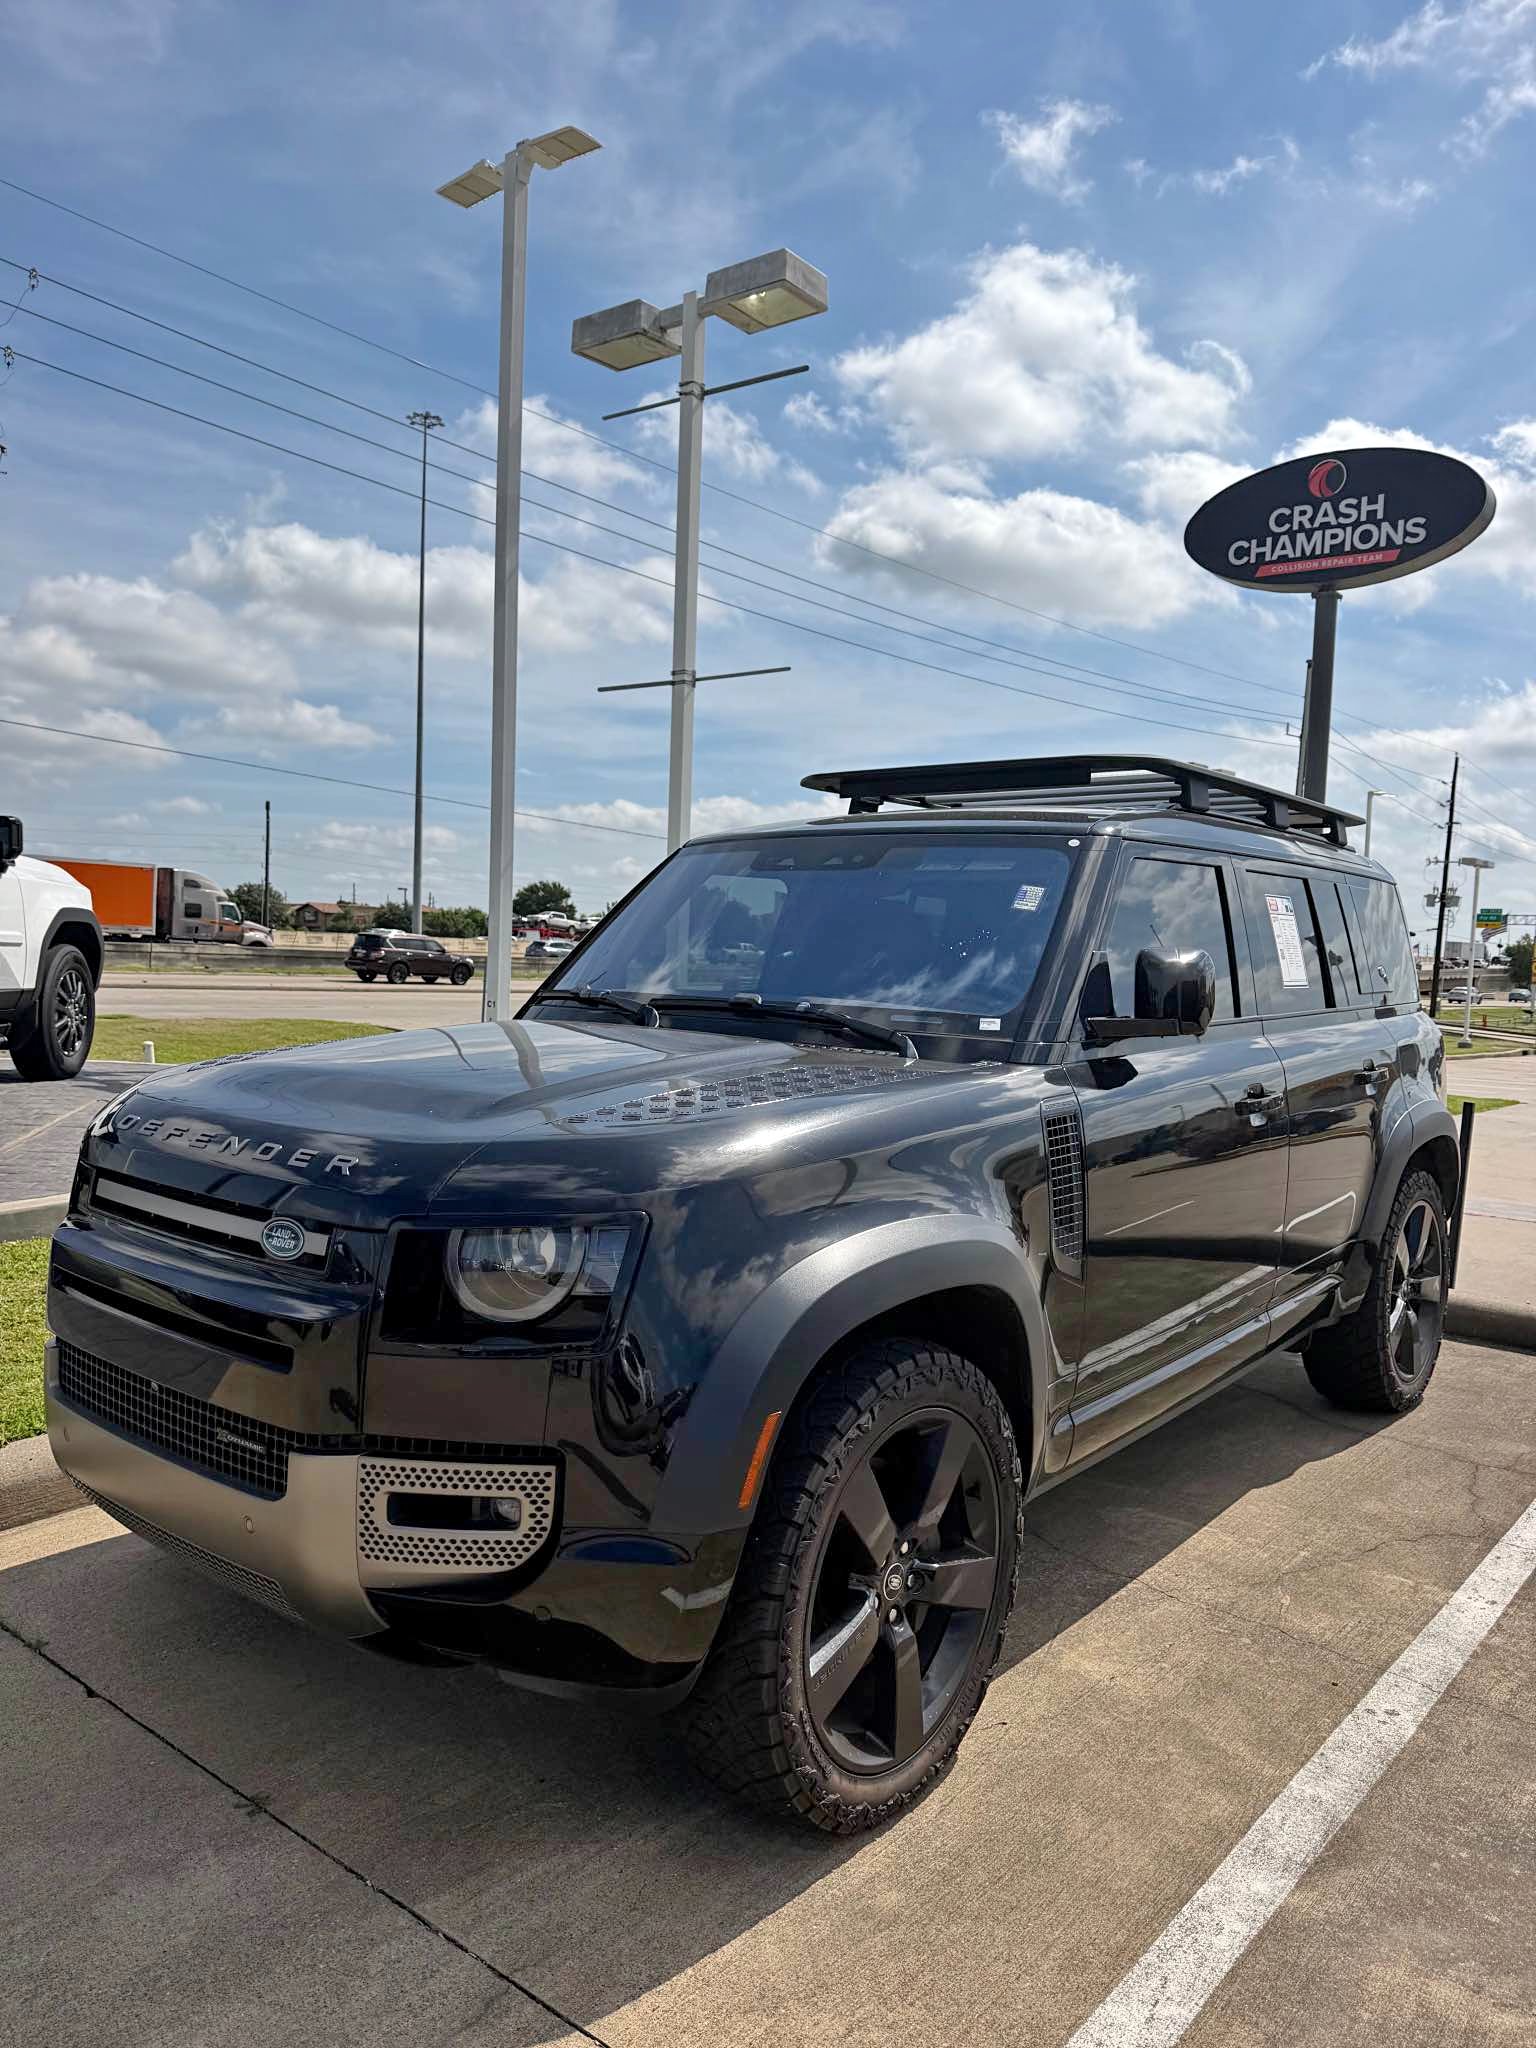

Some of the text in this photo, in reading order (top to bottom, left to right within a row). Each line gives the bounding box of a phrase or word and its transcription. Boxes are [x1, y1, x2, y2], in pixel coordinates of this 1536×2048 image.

[1268, 494, 1385, 533] CRASH
[1228, 516, 1427, 566] CHAMPIONS
[1271, 553, 1383, 573] COLLISION REPAIR TEAM
[117, 1114, 360, 1176] DEFENDER
[271, 1237, 295, 1249] ROVER
[272, 1226, 291, 1239] LAND
